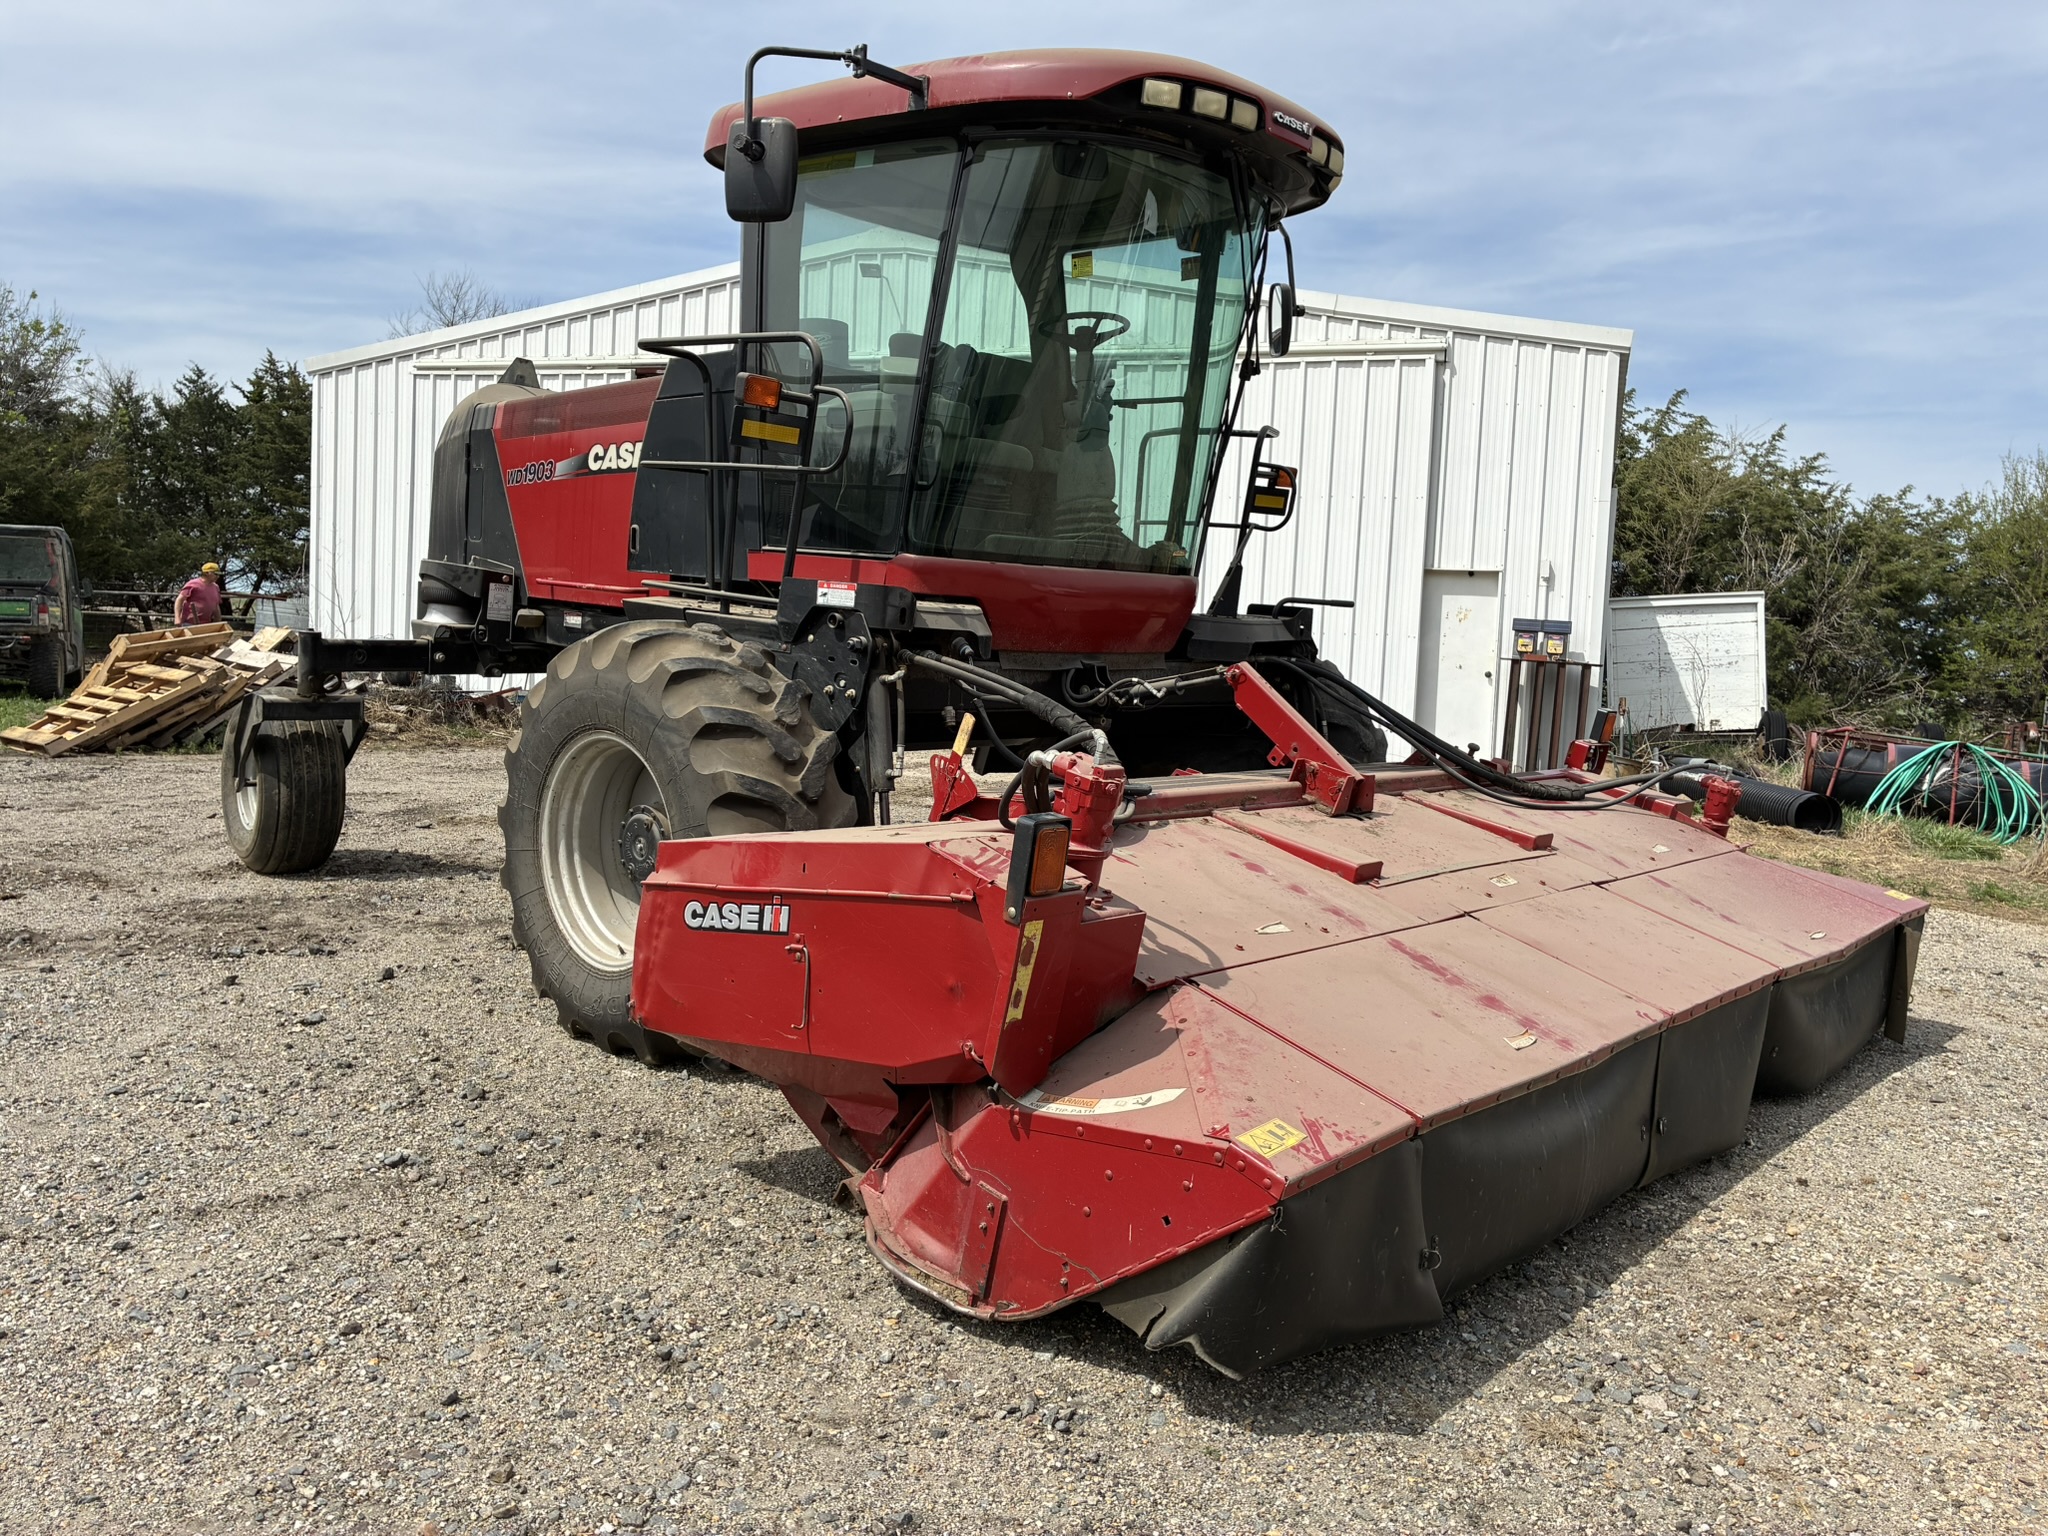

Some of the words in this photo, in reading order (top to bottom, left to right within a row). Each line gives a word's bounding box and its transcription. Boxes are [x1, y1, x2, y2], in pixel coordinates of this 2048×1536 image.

[1276, 112, 1302, 132] CASE
[506, 459, 556, 487] WD1903
[1052, 1096, 1095, 1107] WARNING
